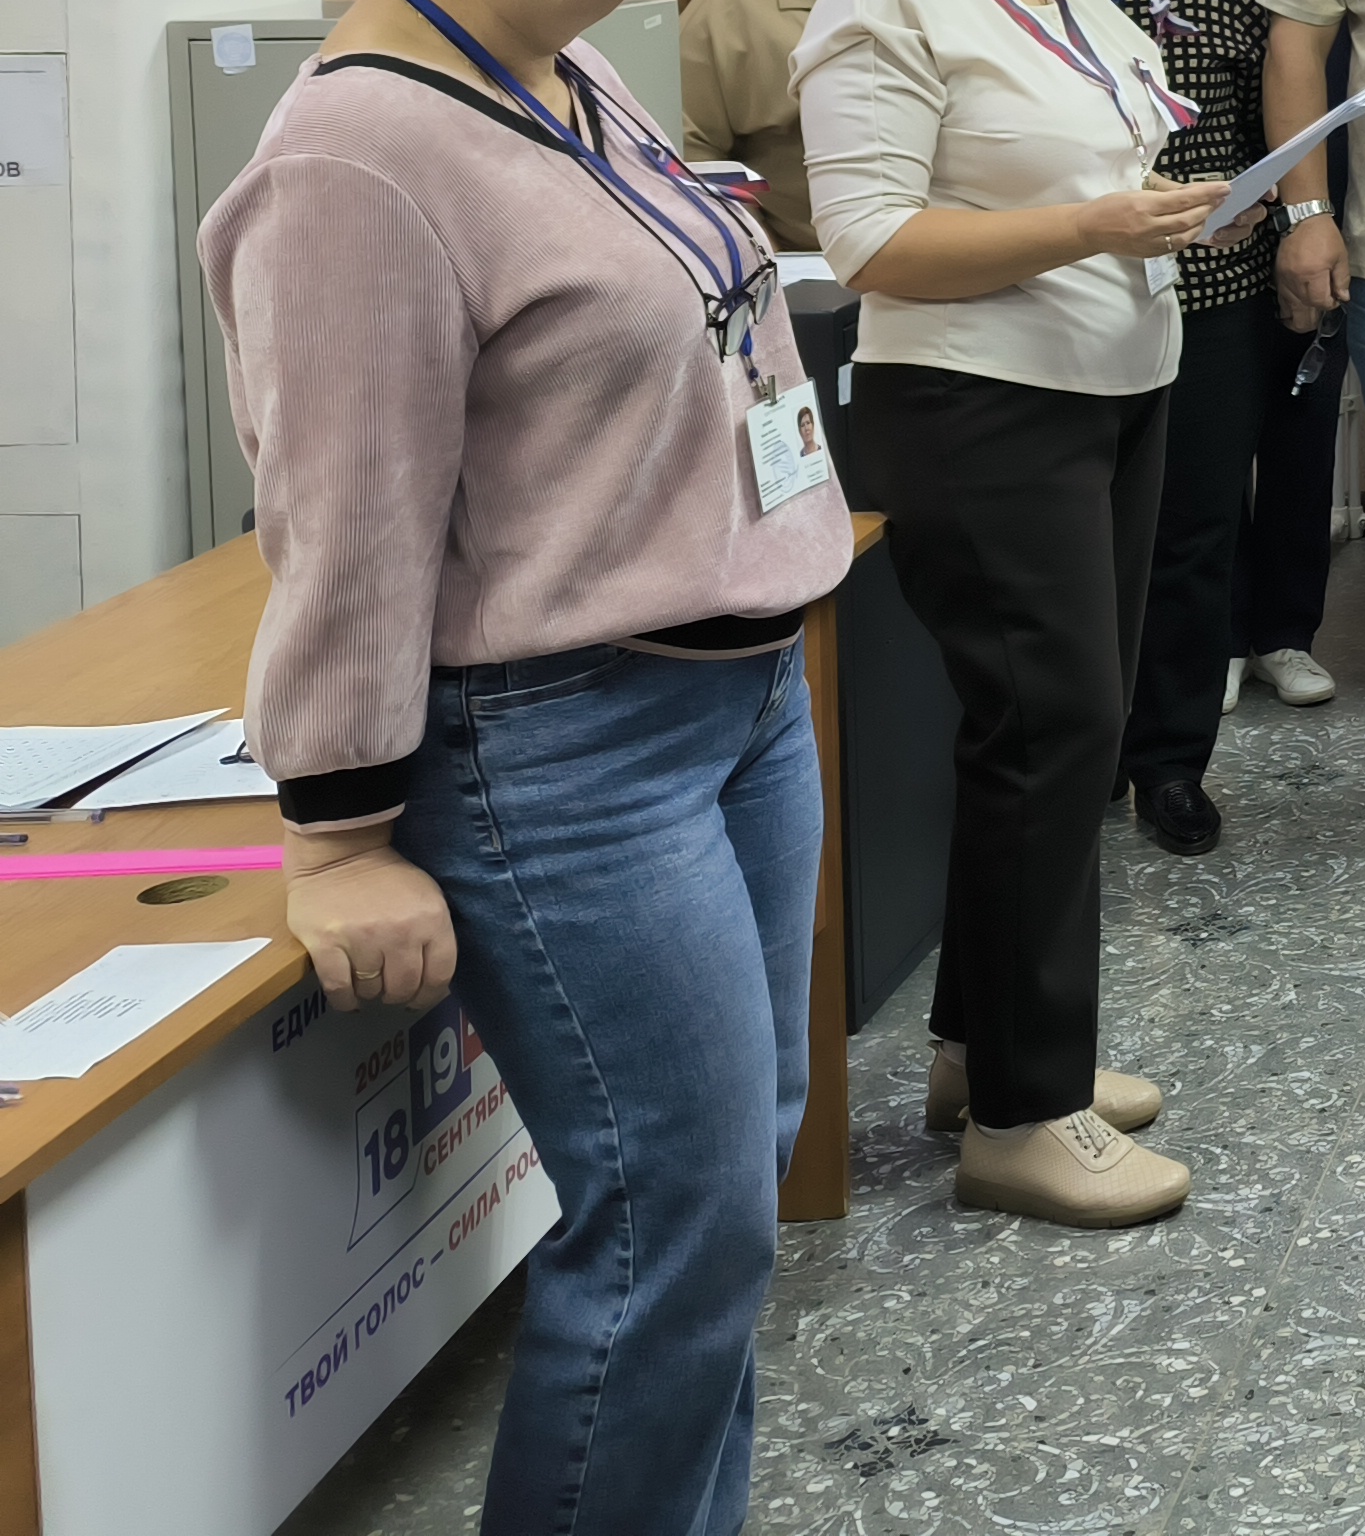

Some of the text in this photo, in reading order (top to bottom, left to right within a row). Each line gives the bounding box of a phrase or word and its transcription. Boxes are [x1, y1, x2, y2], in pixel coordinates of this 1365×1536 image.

[355, 1029, 406, 1097] 2026
[415, 1026, 458, 1111] 19
[364, 1108, 411, 1197] 18
[284, 1331, 349, 1419] ТВОЙ
[354, 1257, 425, 1352] ГОЛОС
[447, 1181, 501, 1252] СИЛА
